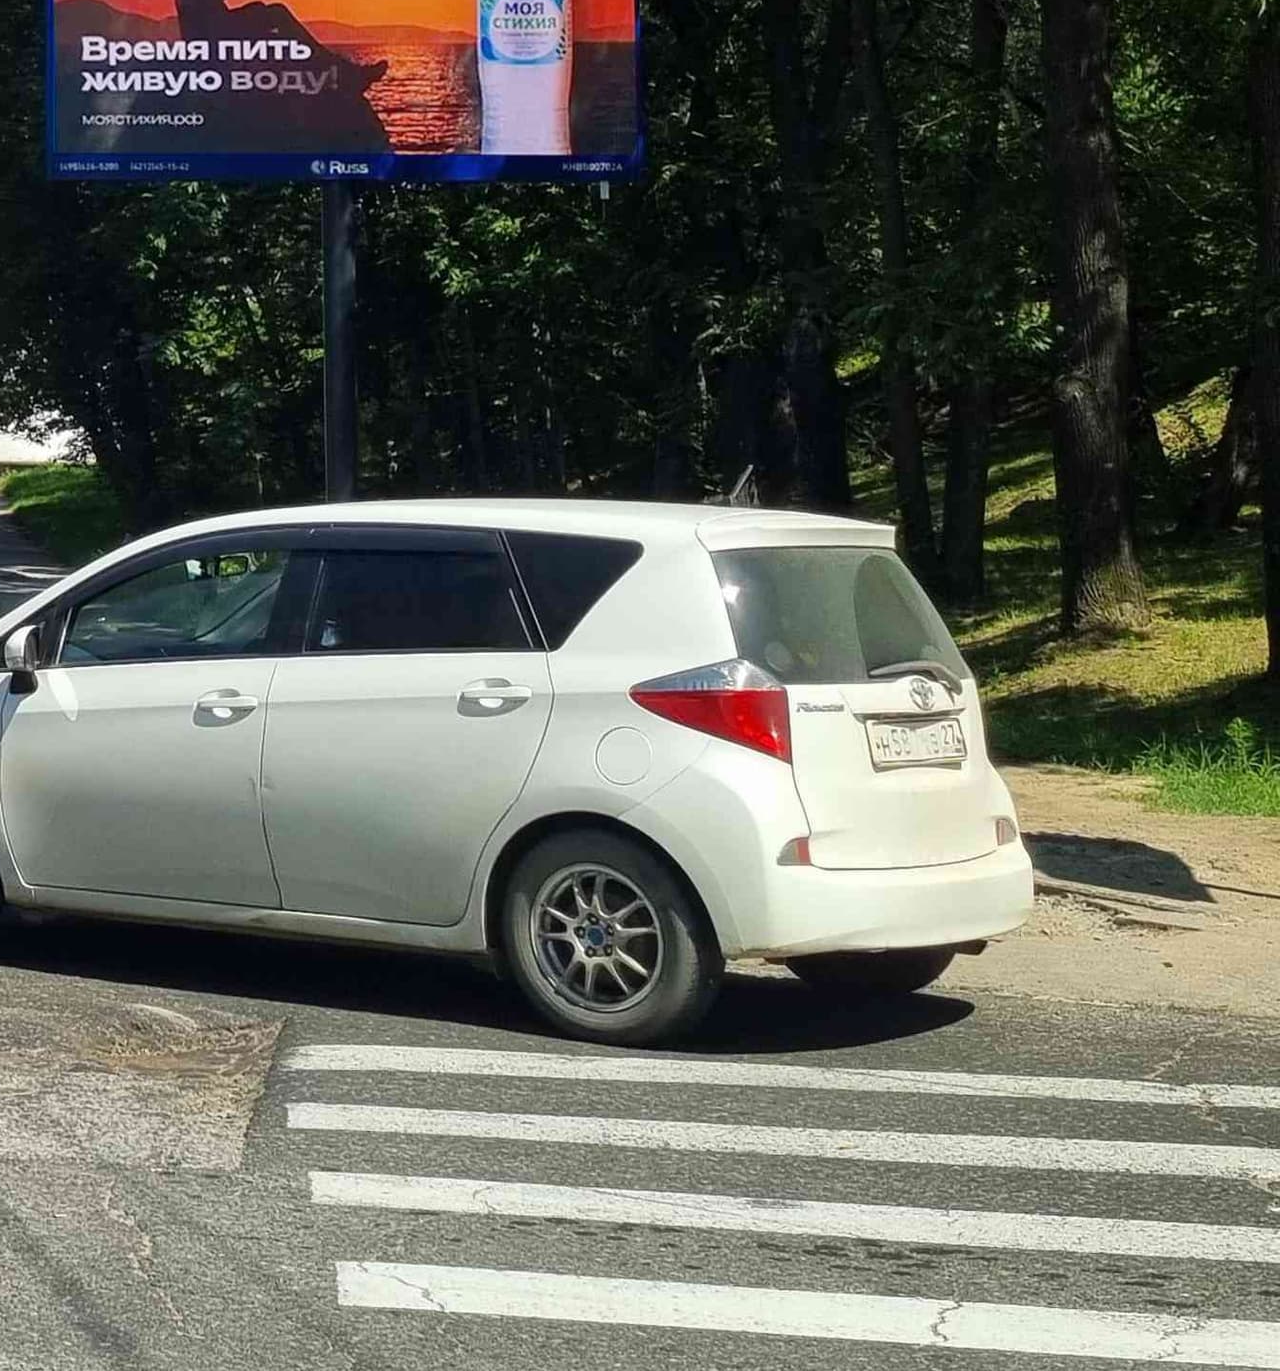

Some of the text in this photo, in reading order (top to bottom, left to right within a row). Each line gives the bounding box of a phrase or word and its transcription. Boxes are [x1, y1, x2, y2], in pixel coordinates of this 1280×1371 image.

[504, 2, 545, 15] МОЯ
[493, 17, 557, 29] СТИХИЯ
[81, 35, 313, 66] Время пить
[81, 65, 339, 96] живую воду!
[330, 160, 369, 174] Russ
